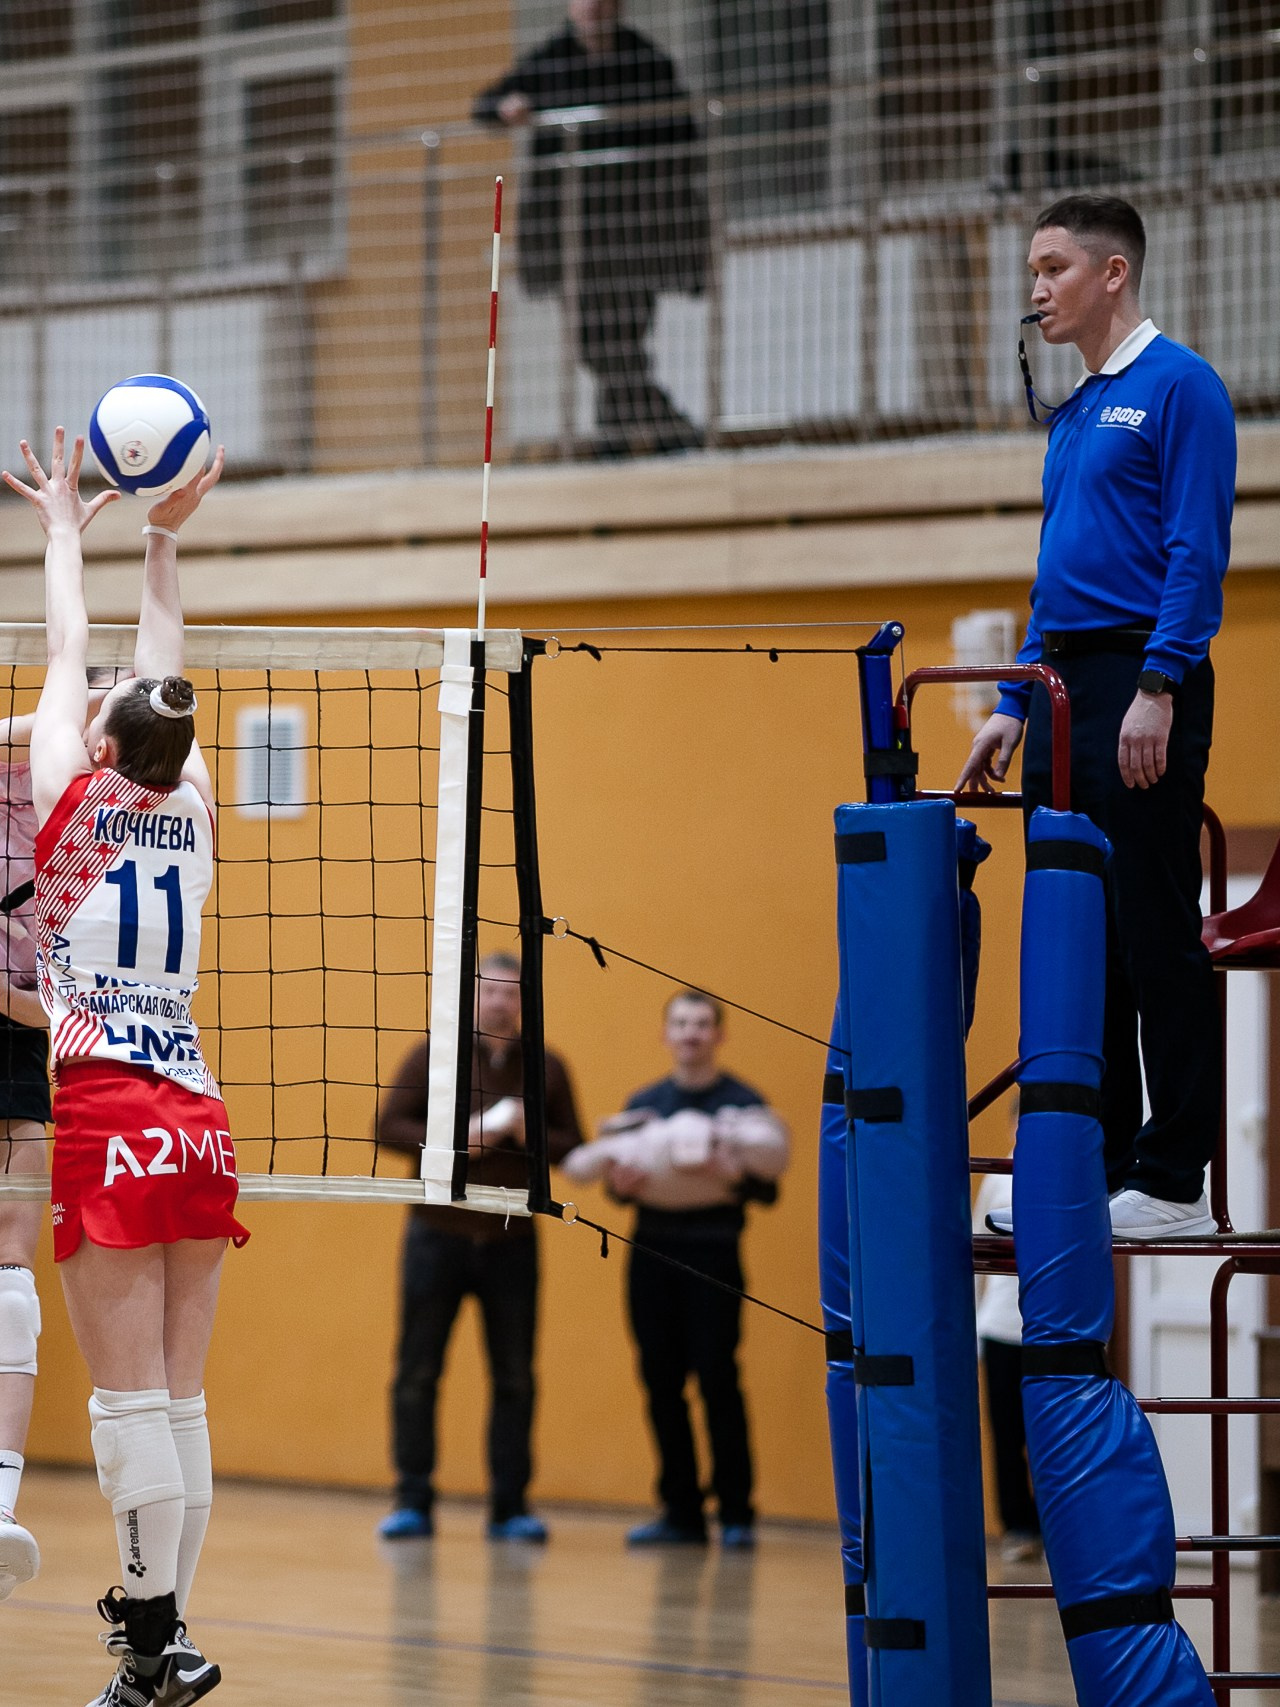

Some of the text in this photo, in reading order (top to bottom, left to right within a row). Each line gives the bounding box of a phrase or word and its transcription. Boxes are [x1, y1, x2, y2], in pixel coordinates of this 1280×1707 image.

[94, 807, 195, 853] КОЧНЕВА
[105, 859, 184, 975] 11
[103, 1127, 237, 1188] A2ME
